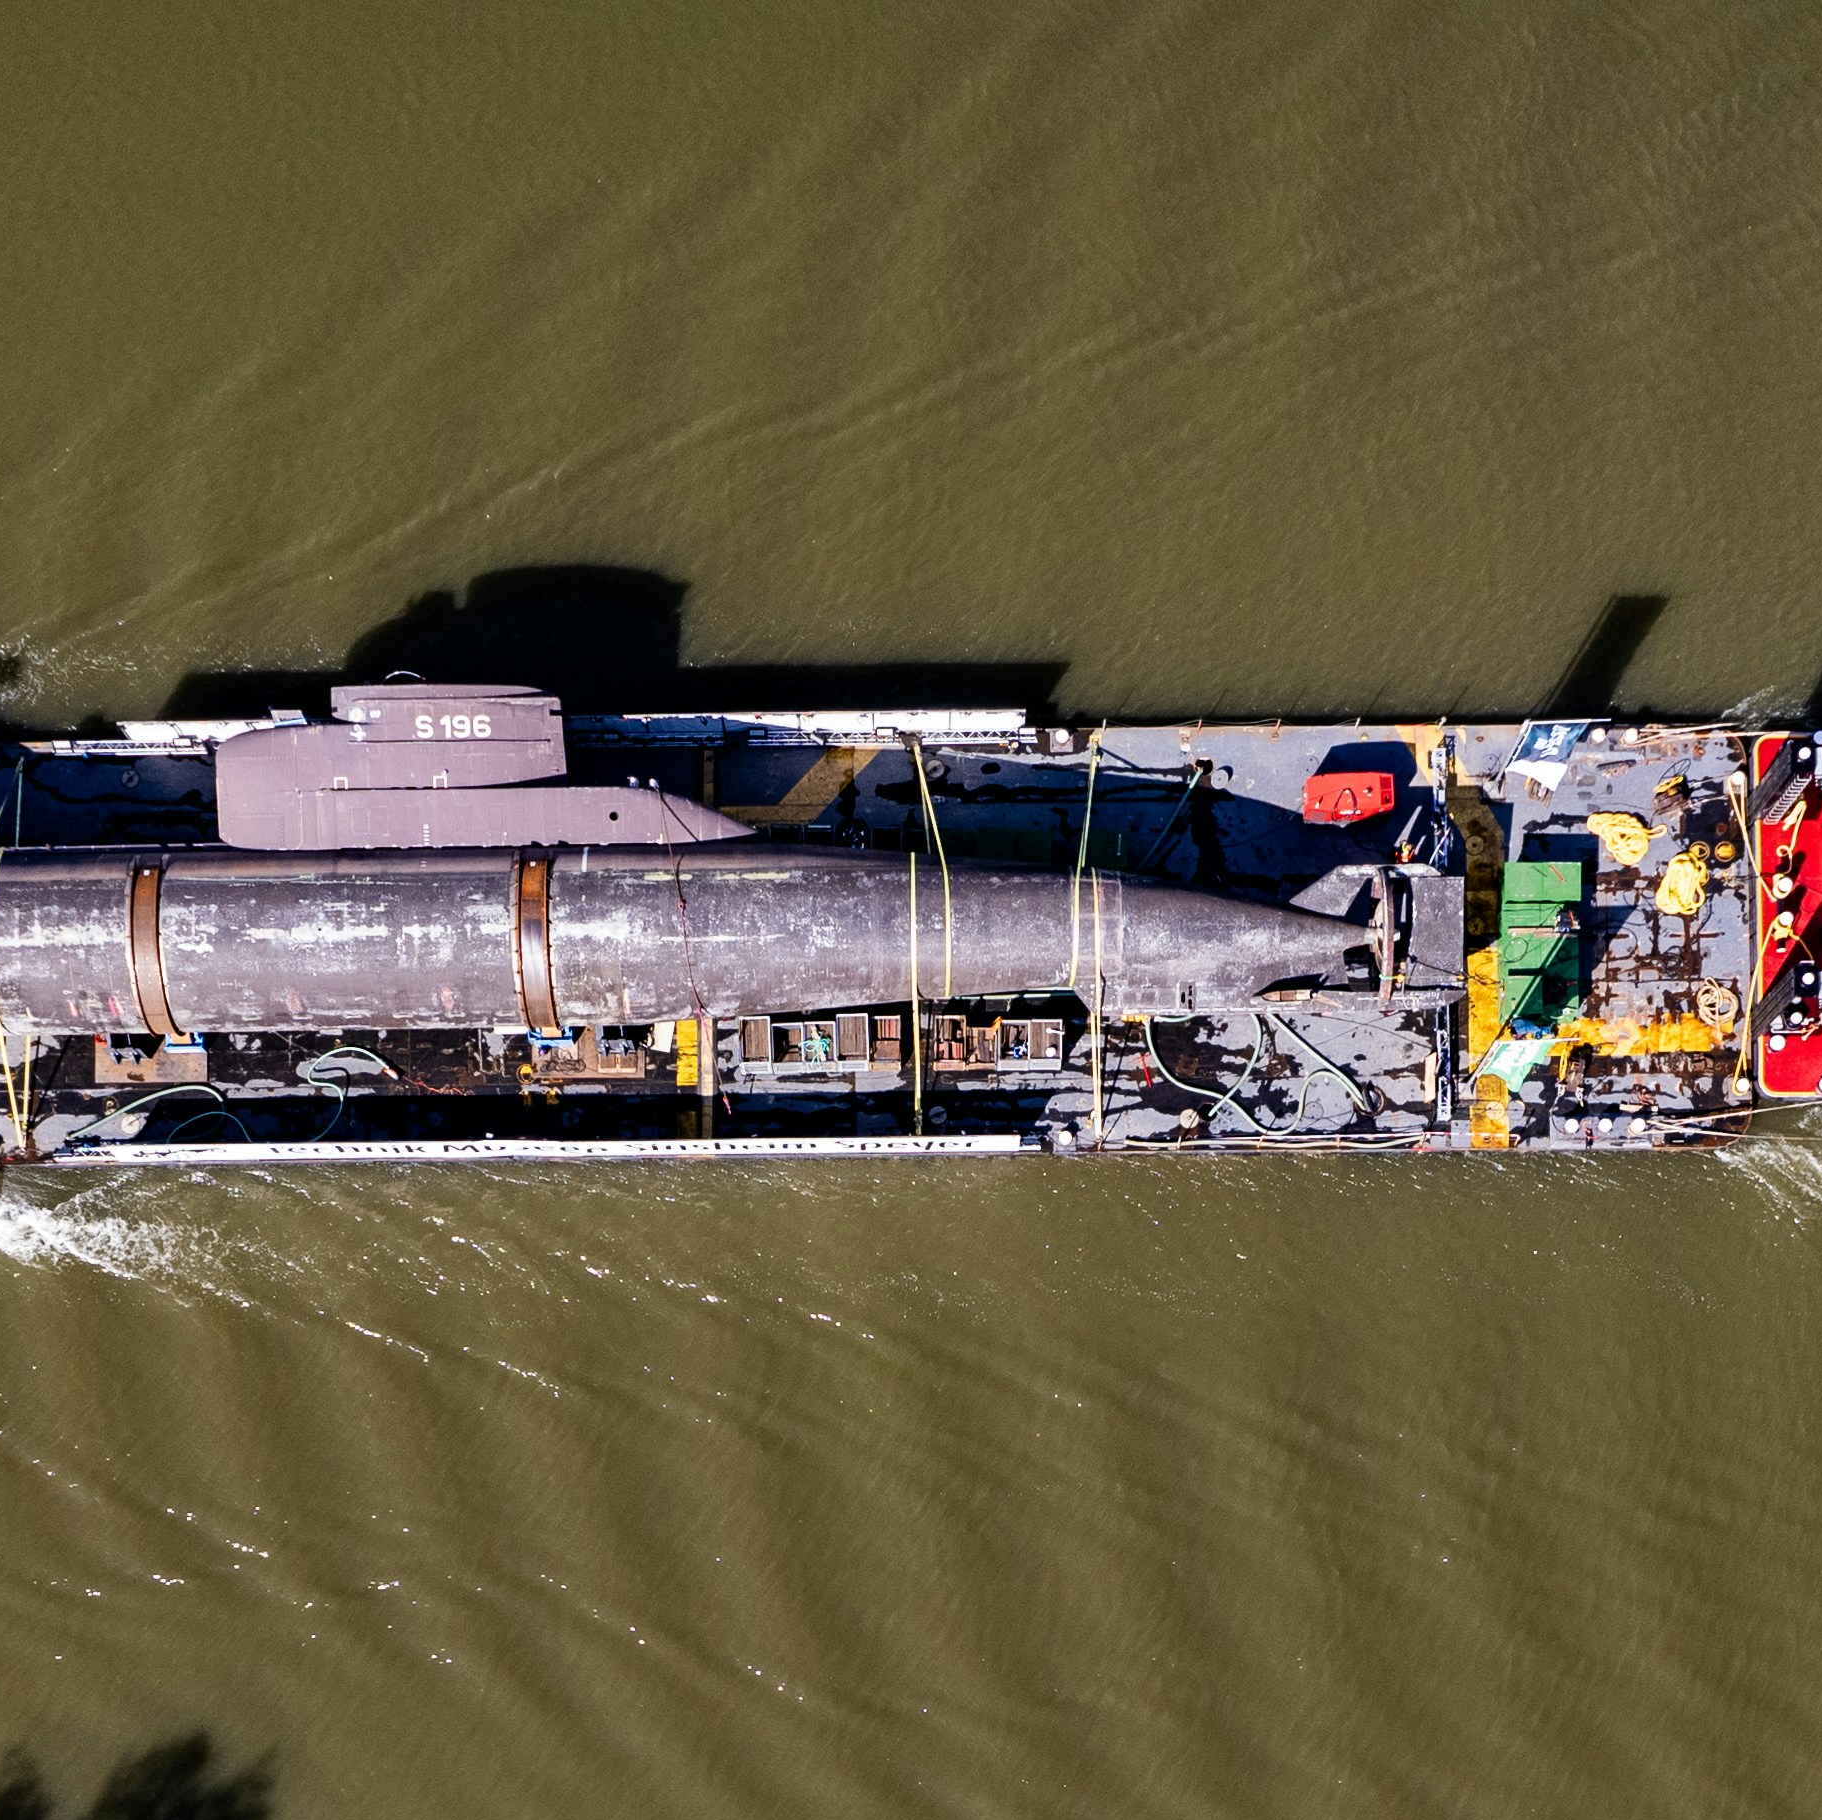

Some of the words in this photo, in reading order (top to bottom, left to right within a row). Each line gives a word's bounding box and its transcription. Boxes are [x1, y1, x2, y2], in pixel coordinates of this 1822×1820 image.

[415, 714, 433, 738] S
[439, 714, 492, 738] 196
[834, 1140, 980, 1151] Speyer
